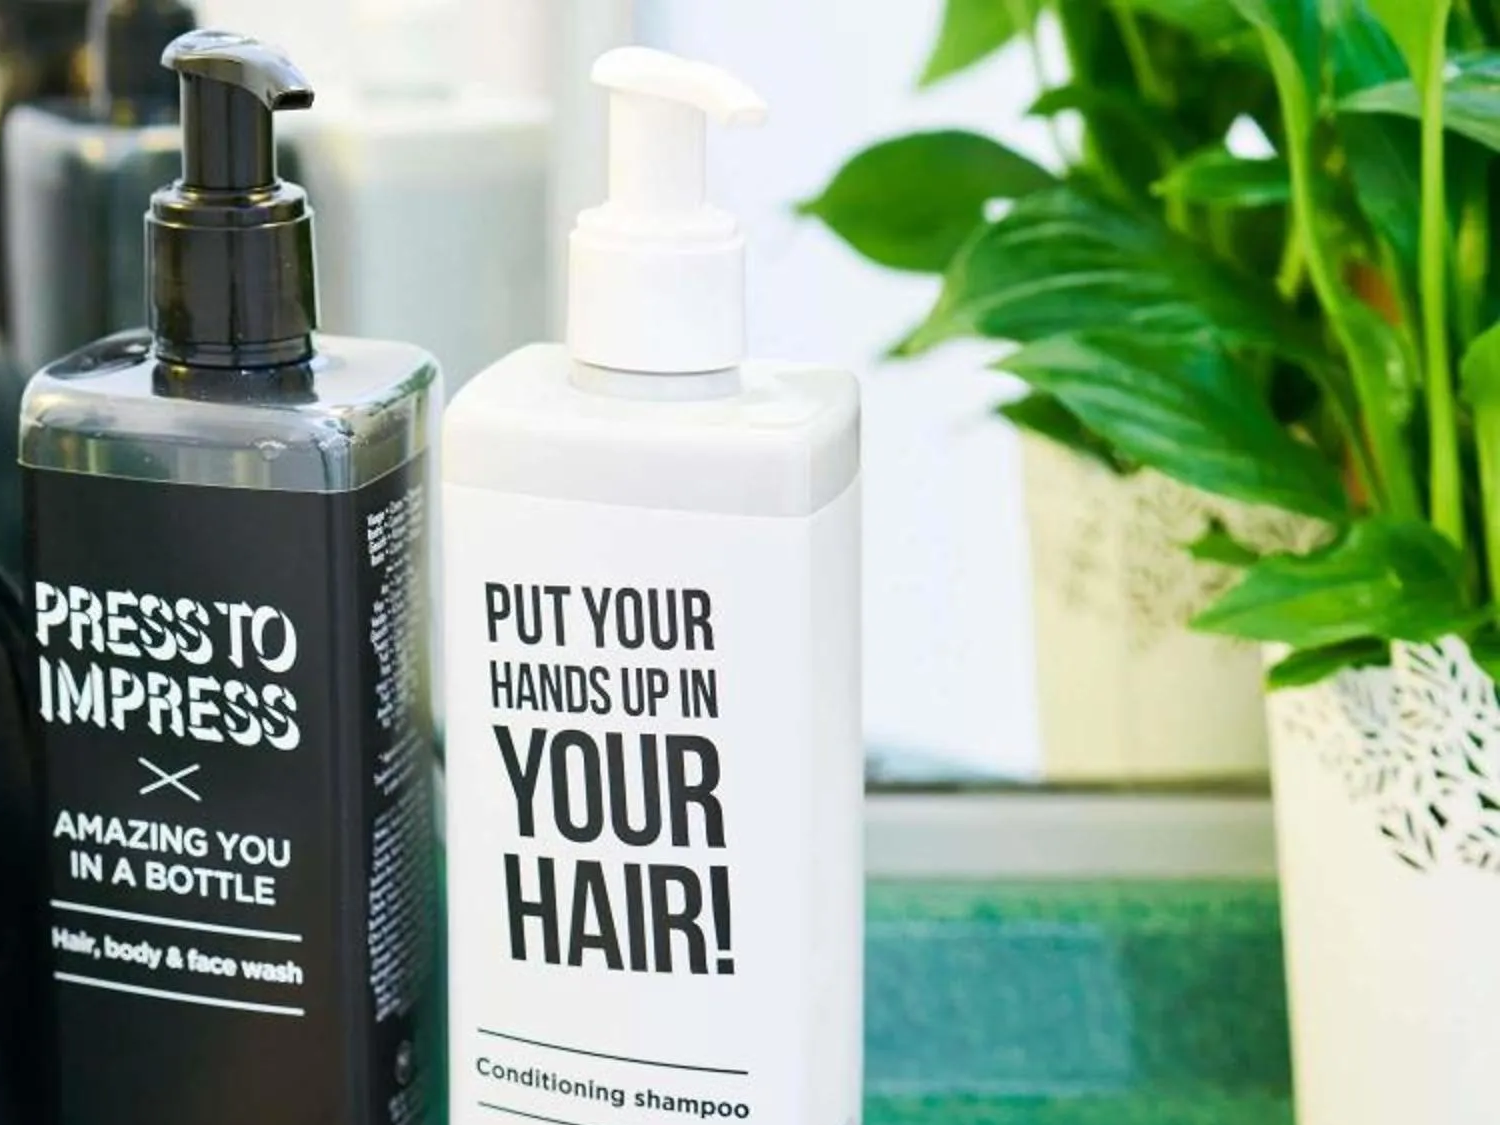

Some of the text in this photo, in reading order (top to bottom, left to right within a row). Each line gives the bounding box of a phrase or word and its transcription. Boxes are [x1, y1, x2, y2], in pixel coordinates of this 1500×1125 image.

[35, 581, 297, 673] PRESS TO
[485, 582, 715, 651] PUT YOUR
[38, 655, 301, 751] IMPRESS
[489, 660, 719, 718] HANDS UP IN
[492, 724, 727, 849] YOUR
[53, 809, 291, 868] AMAZING YOU
[70, 849, 277, 907] IN A BOTTLE
[503, 853, 735, 976] HAIR!
[51, 926, 304, 985] Hair, body & face wash
[476, 1056, 750, 1119] Conditioning shampoo
